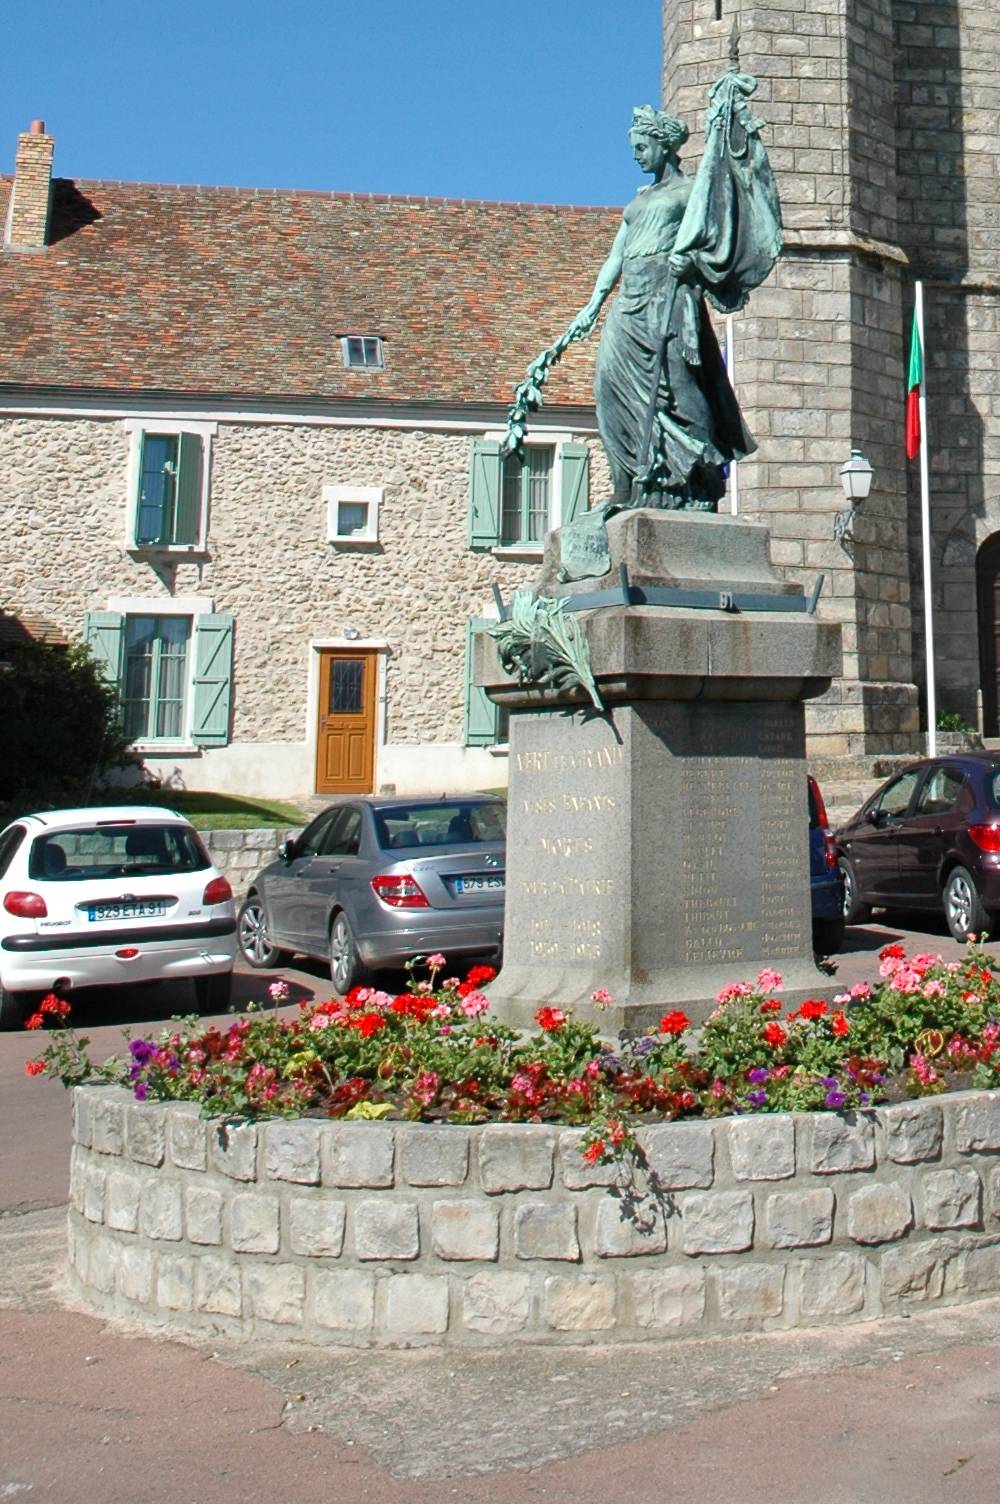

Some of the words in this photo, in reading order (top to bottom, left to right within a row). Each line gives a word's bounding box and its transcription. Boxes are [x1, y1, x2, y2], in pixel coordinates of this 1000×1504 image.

[97, 906, 120, 920] 929
[122, 903, 145, 917] ETA
[149, 901, 162, 914] 91
